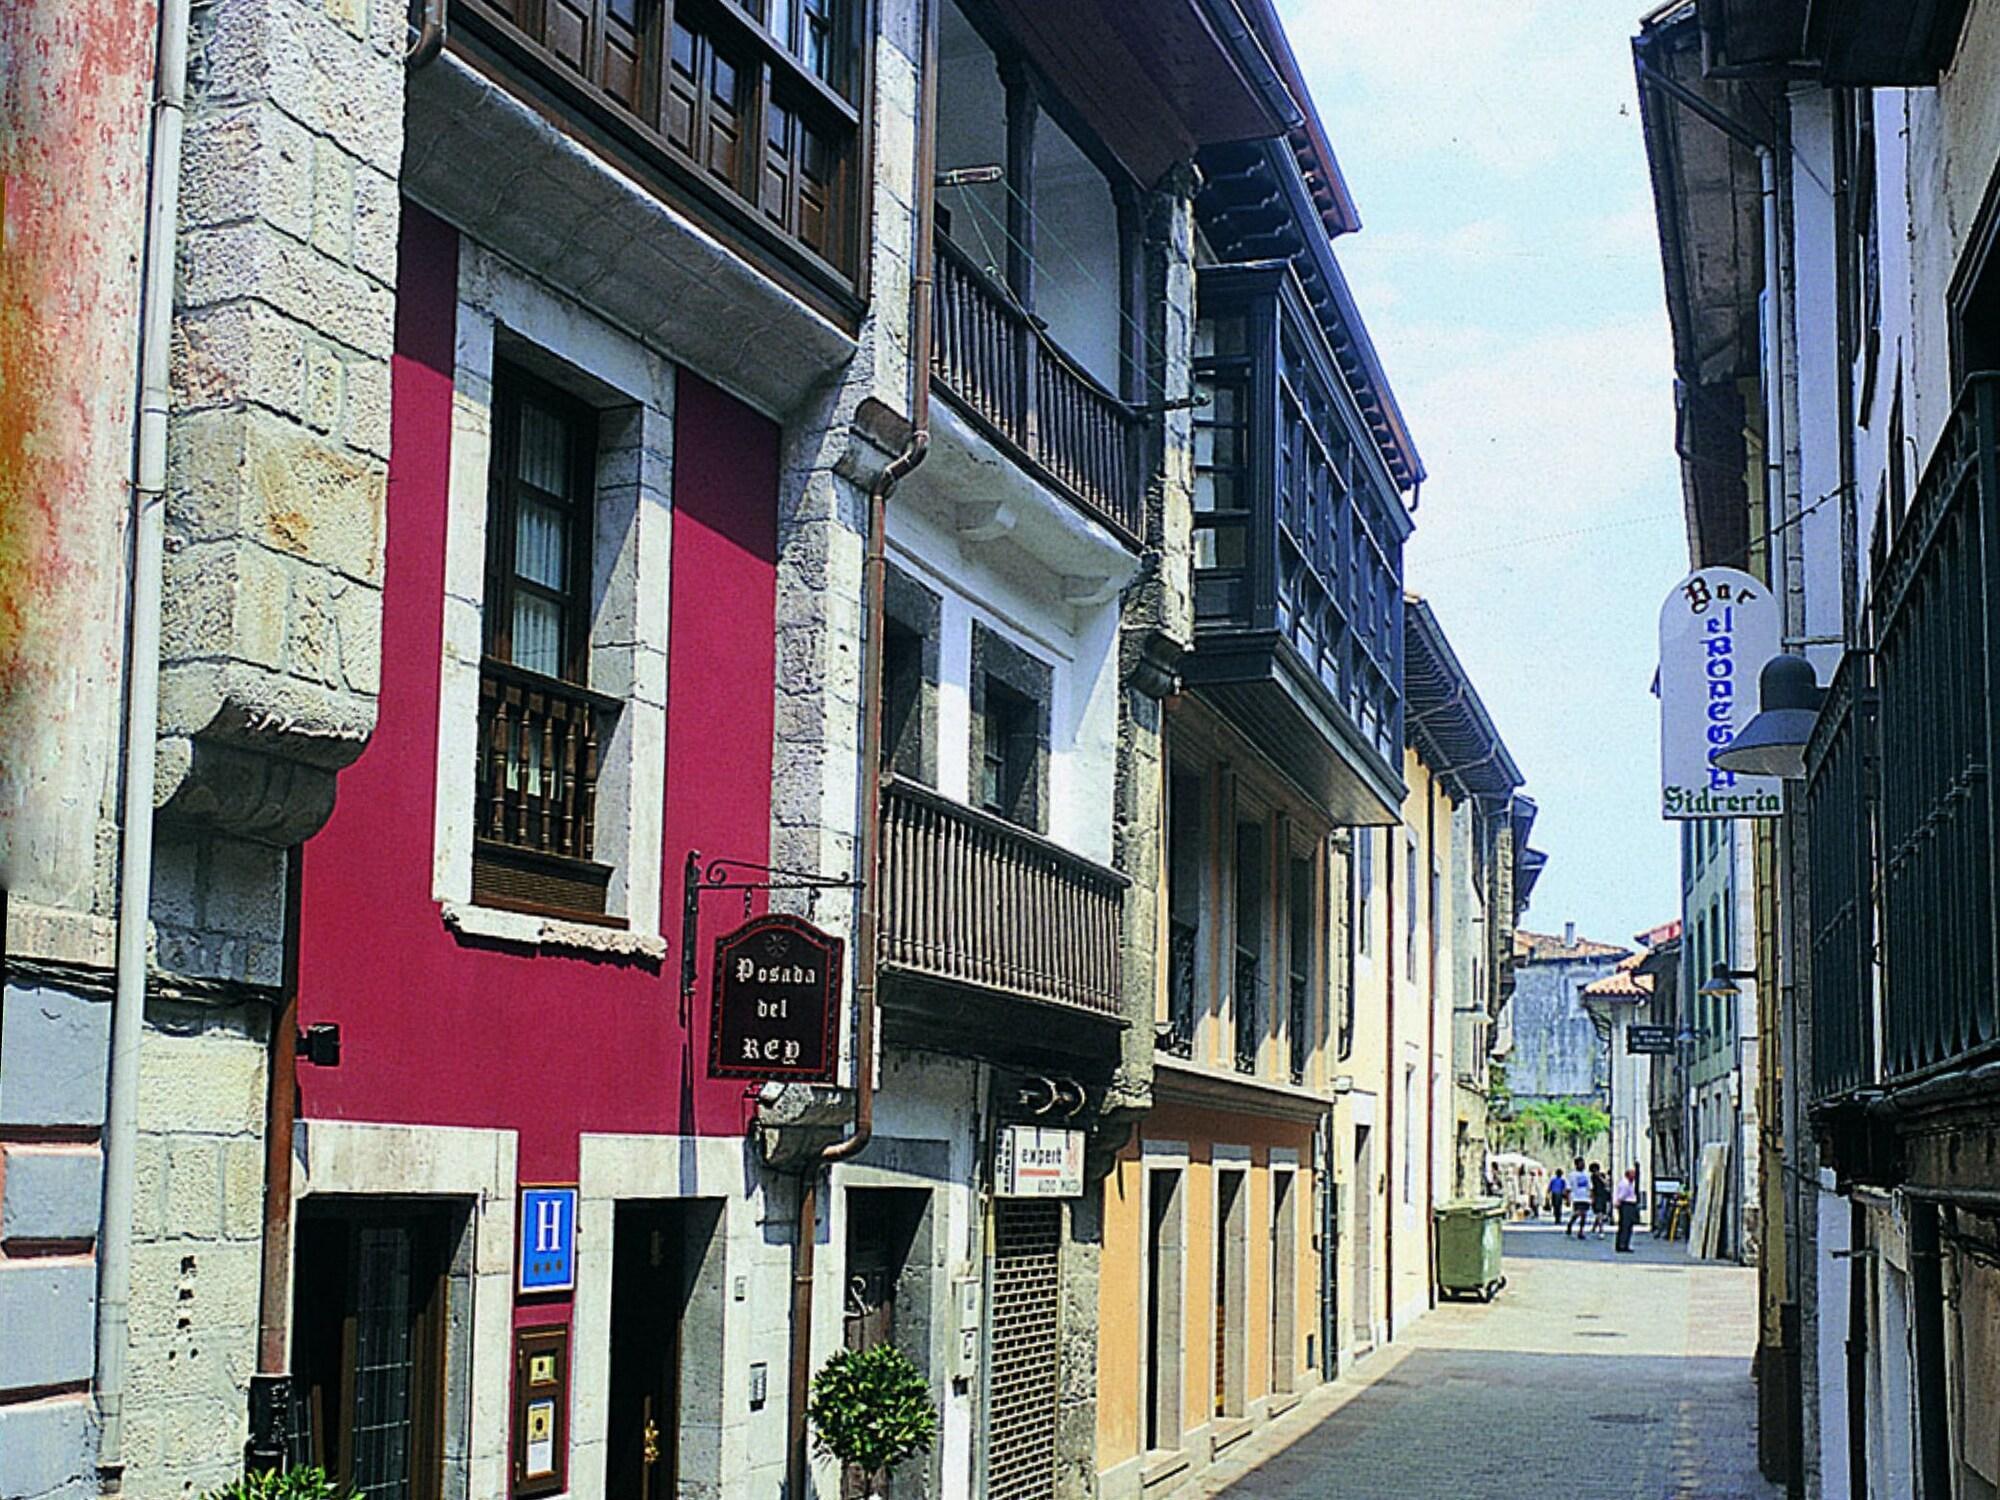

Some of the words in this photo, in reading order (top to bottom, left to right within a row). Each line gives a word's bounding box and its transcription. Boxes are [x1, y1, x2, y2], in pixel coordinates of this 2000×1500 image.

[1681, 576, 1757, 614] Bar
[1707, 606, 1732, 633] el
[1664, 785, 1780, 813] Sidreria
[736, 957, 816, 984] Posada
[757, 999, 788, 1018] del
[741, 1038, 800, 1065] REY
[536, 1200, 562, 1252] H
